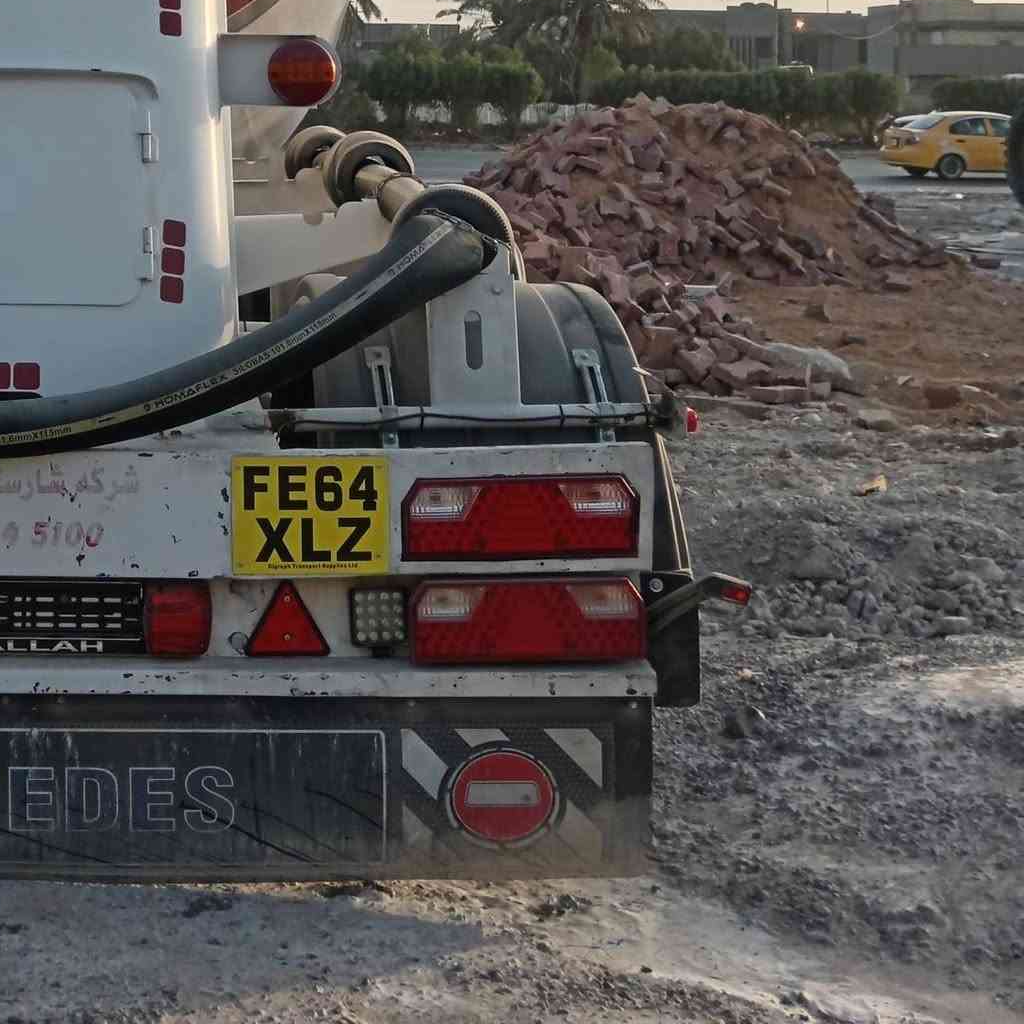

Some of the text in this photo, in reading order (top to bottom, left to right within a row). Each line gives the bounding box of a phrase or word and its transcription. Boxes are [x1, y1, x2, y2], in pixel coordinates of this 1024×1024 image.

[153, 373, 229, 410] HOMAFLEX
[243, 465, 378, 511] FE64
[31, 520, 105, 548] 5100
[256, 517, 372, 563] XLZ
